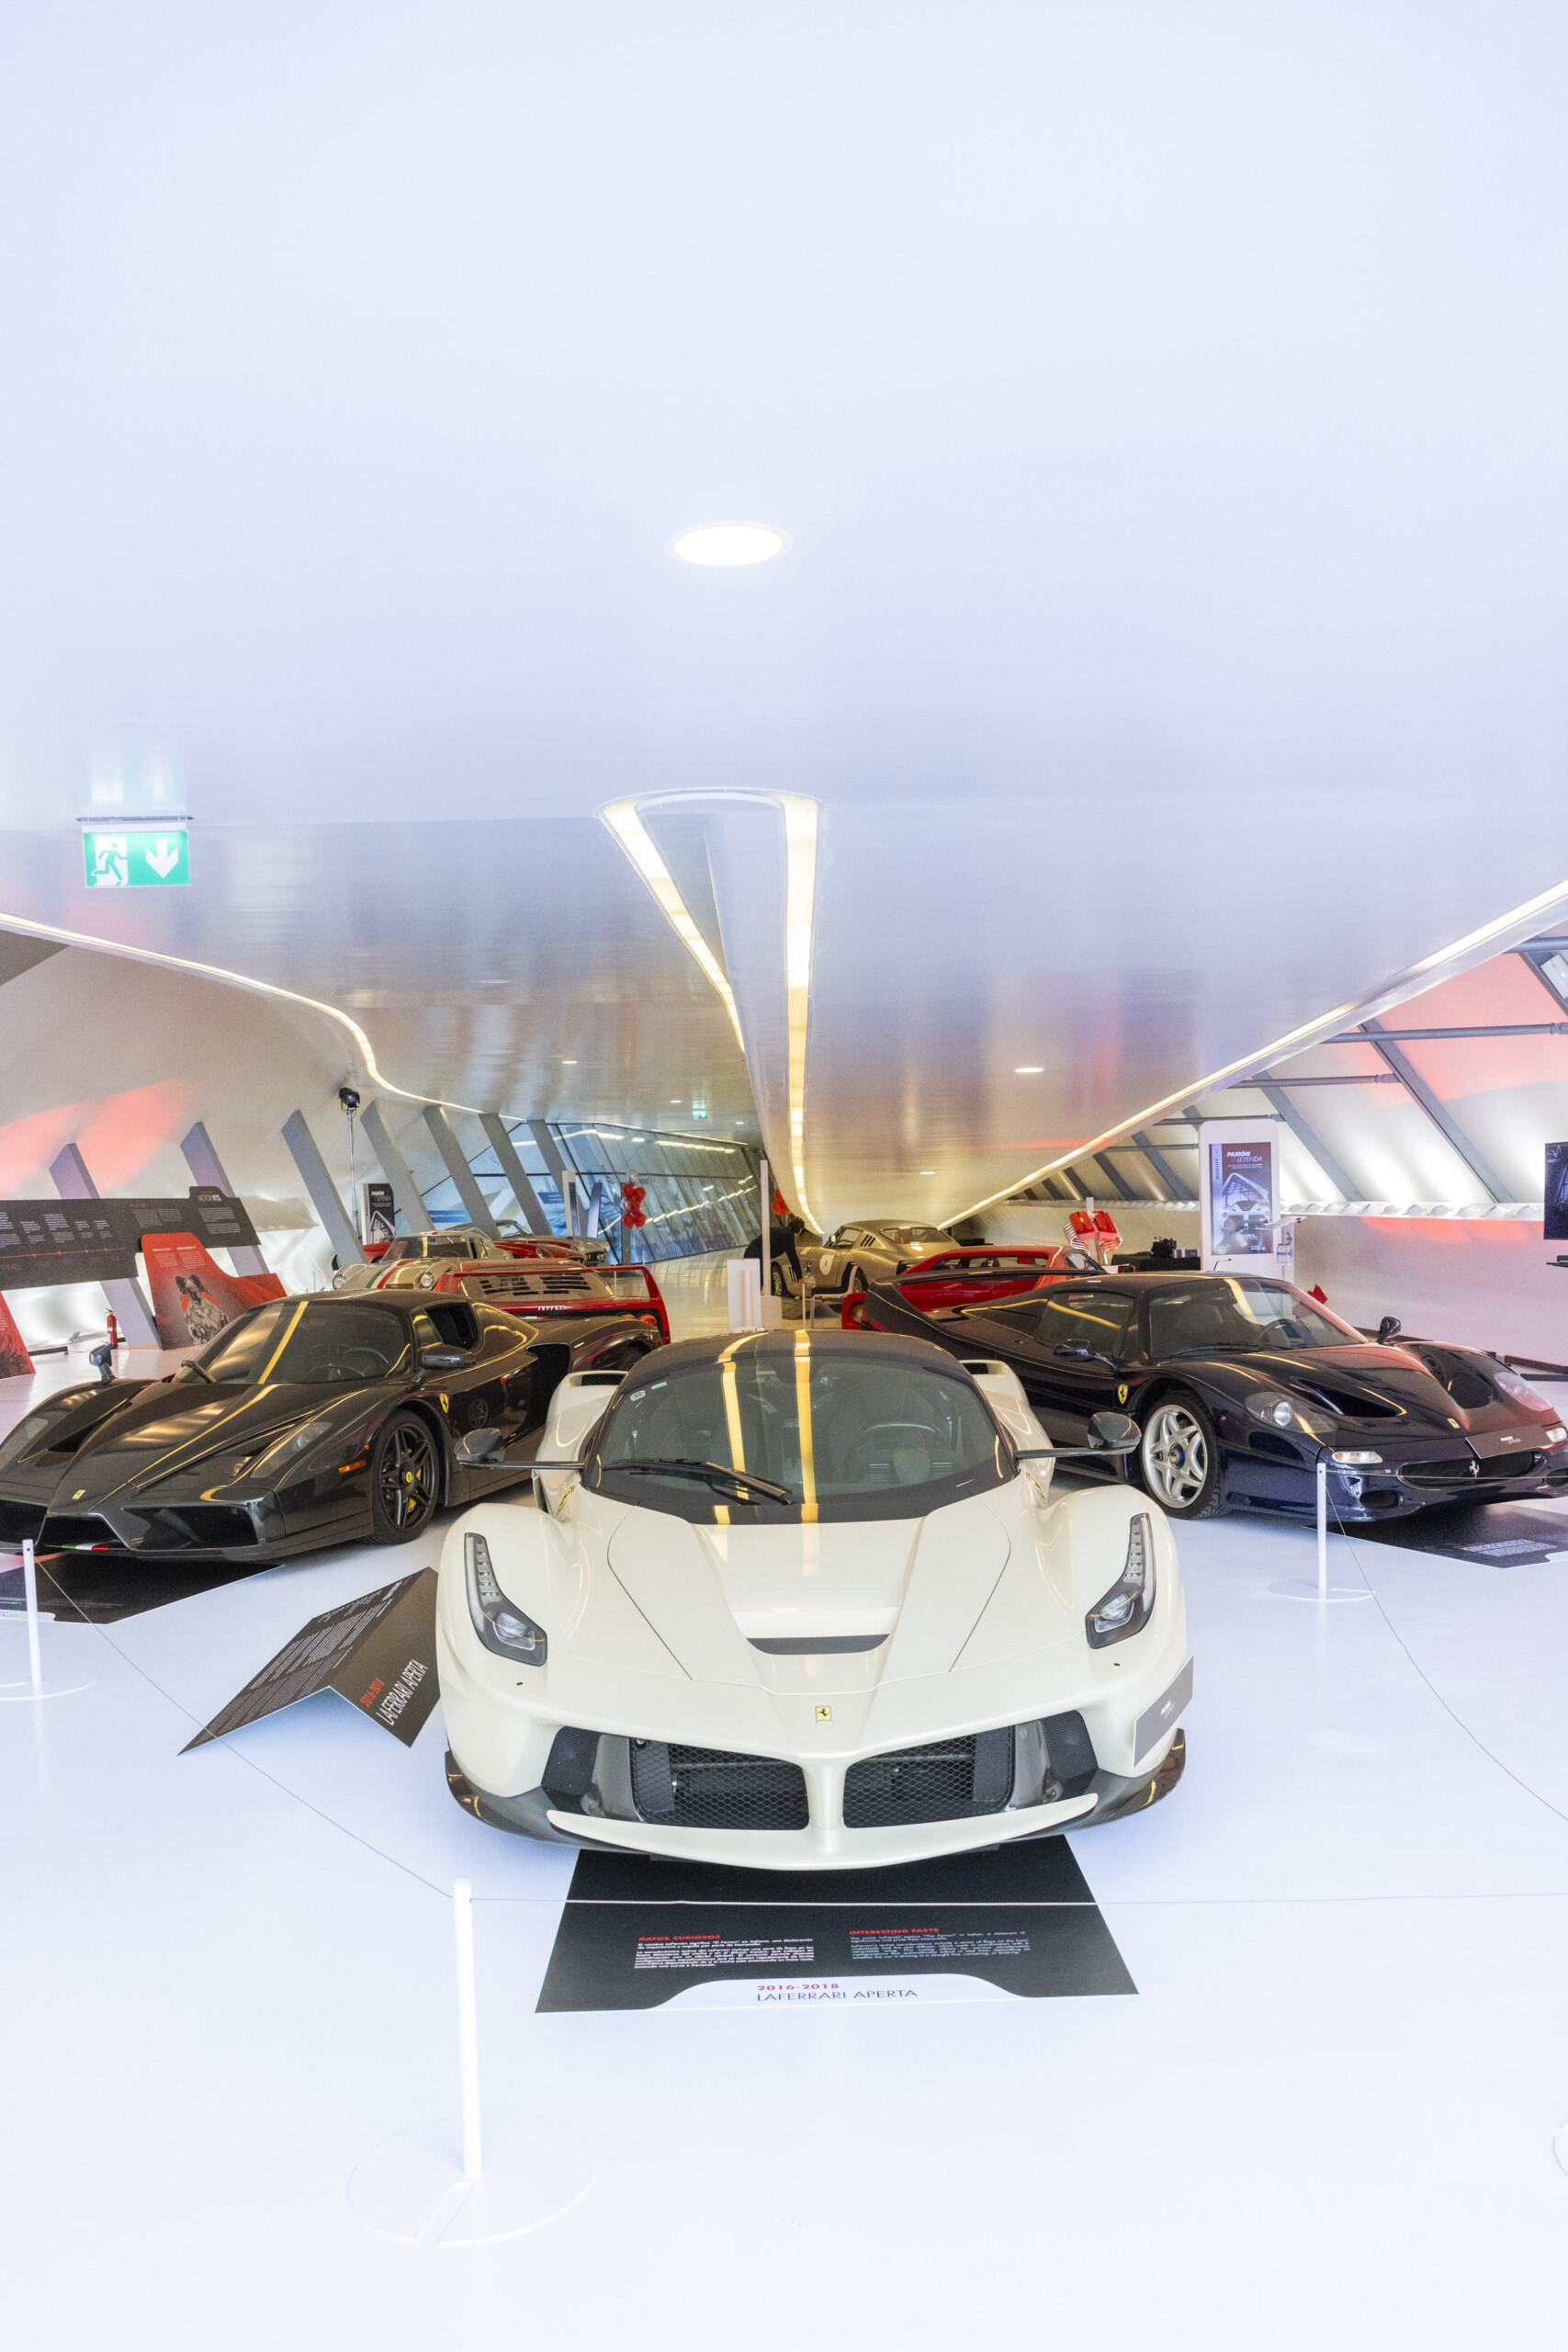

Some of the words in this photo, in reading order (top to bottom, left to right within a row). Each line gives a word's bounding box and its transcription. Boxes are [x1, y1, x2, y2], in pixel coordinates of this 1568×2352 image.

[360, 1677, 385, 1708] 2016-2018
[376, 1680, 413, 1726] LAFERRARI
[400, 1659, 429, 1690] APERTA
[757, 1991, 846, 2001] LAFERRARI
[853, 1989, 918, 1999] APERTA
